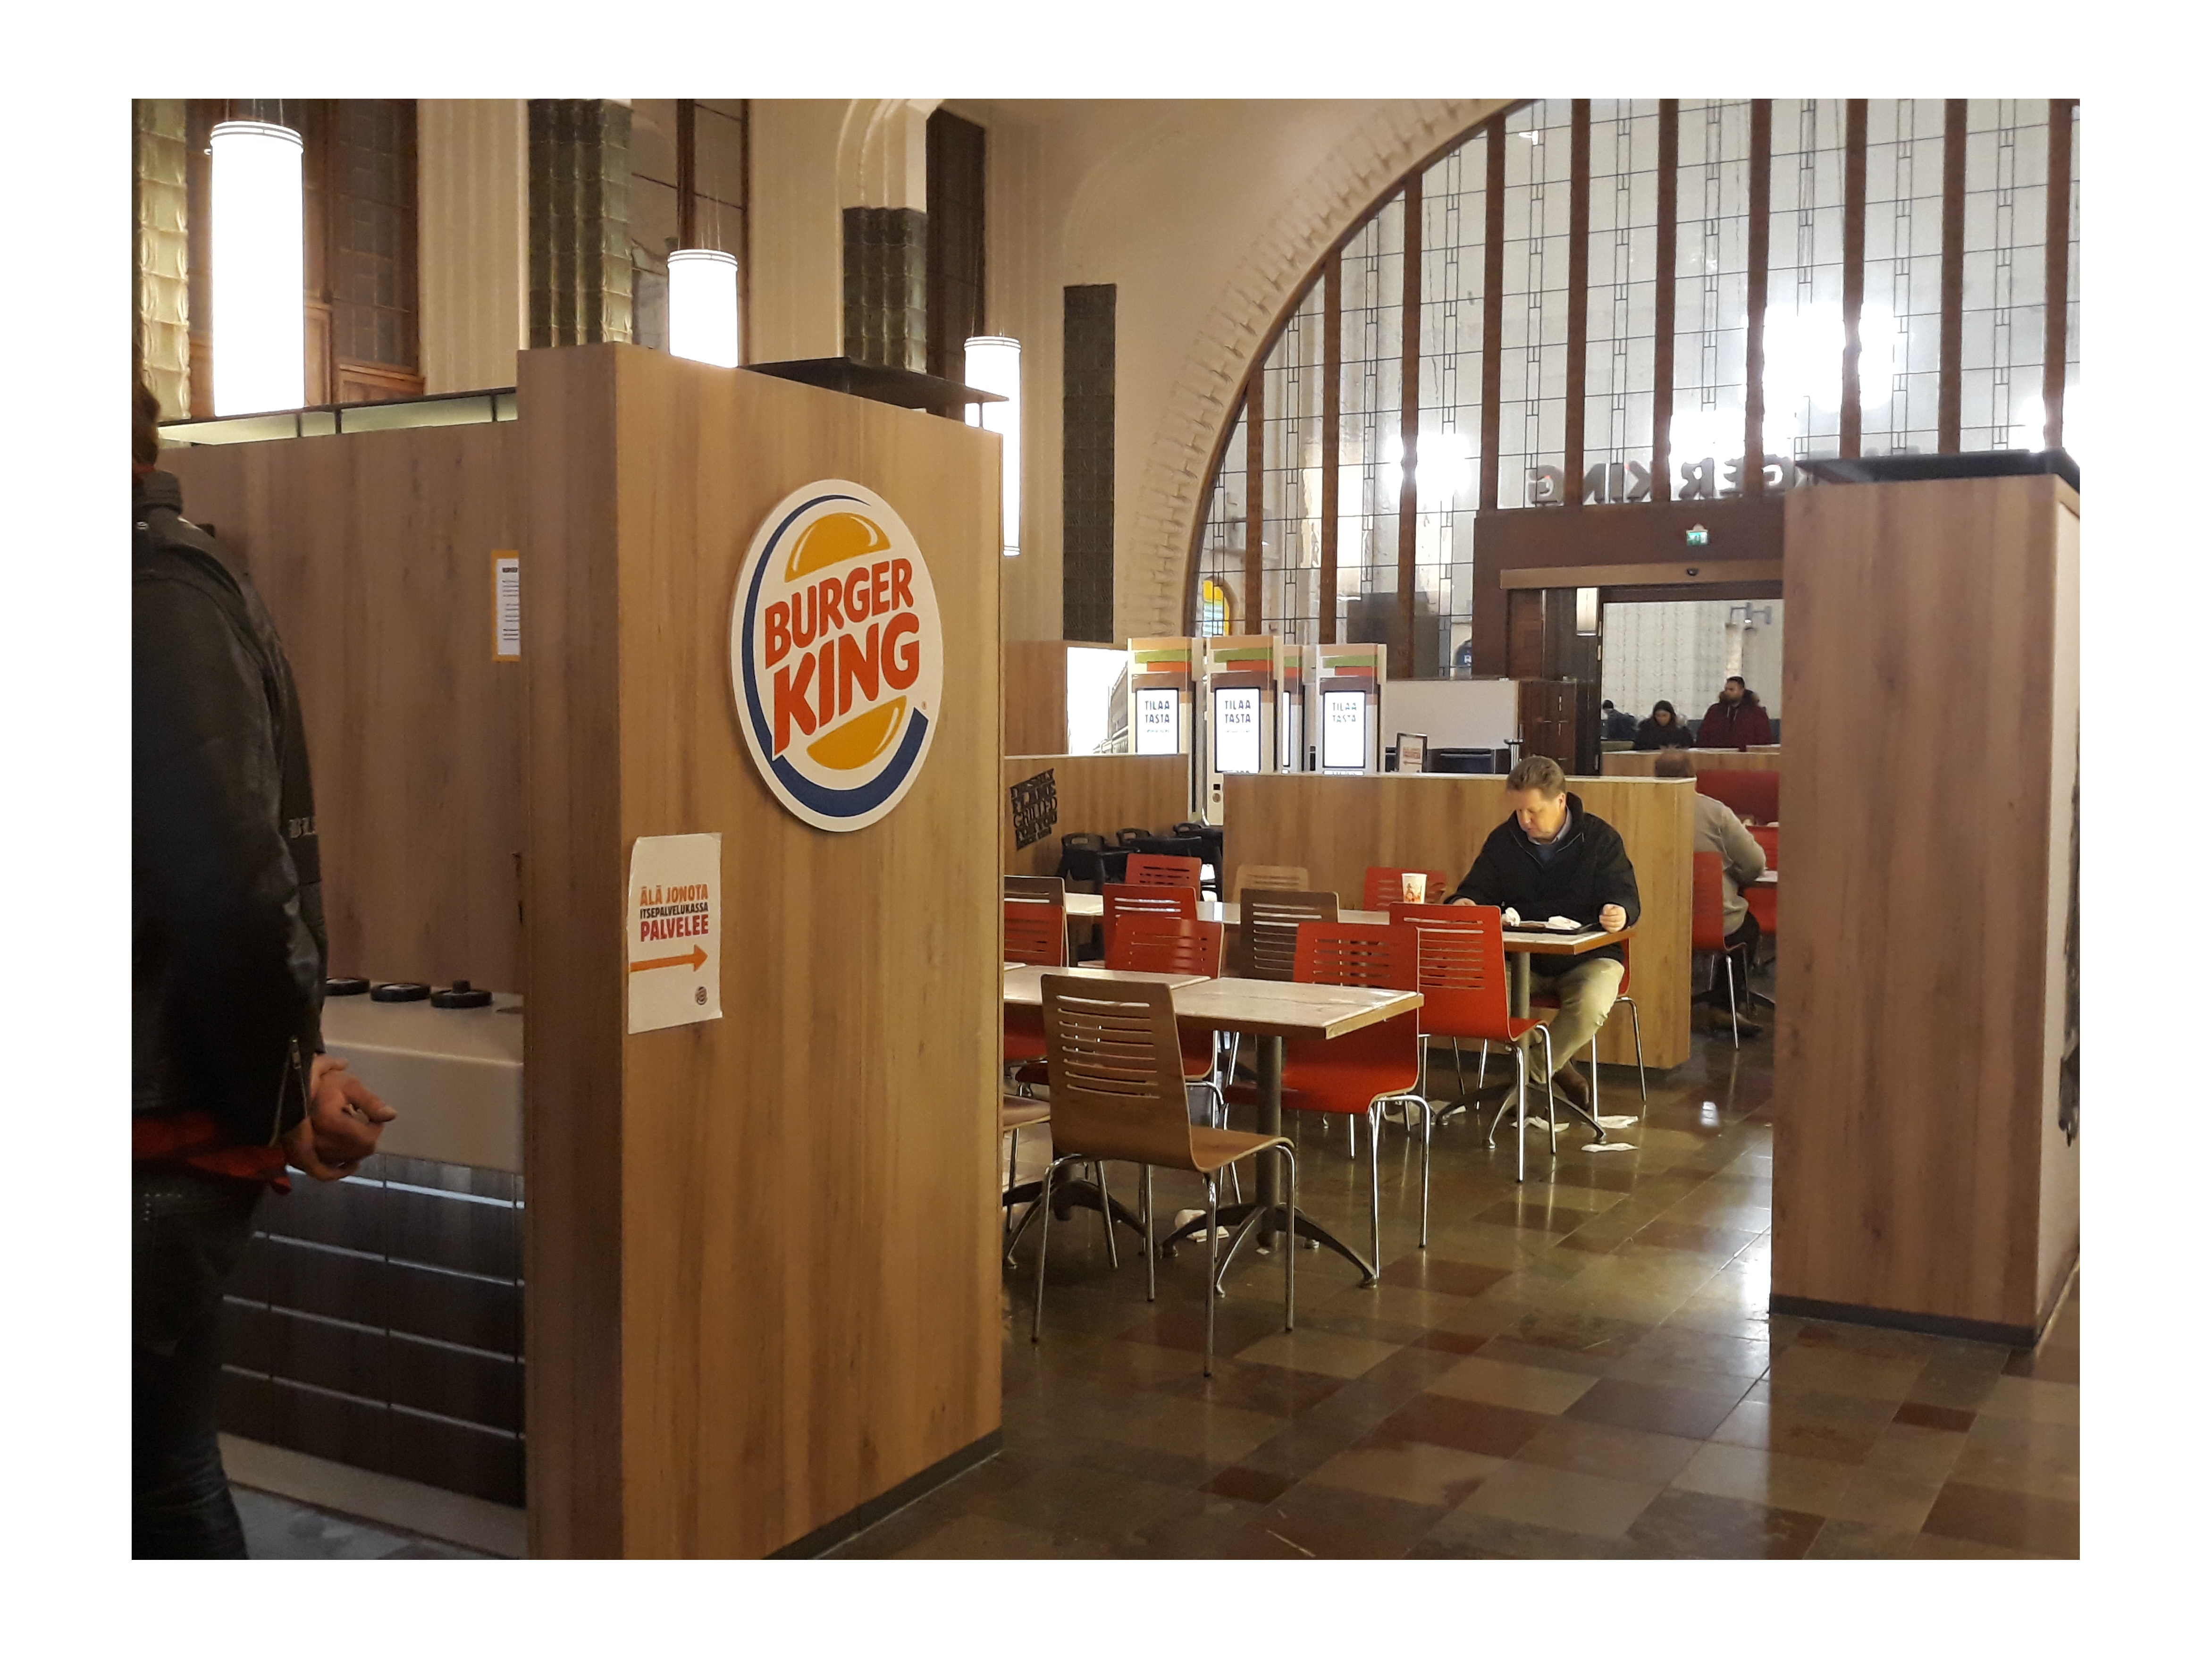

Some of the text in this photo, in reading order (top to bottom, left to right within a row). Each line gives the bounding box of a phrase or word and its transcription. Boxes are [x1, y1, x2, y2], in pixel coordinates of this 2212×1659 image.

[765, 558, 914, 670] BURGER
[774, 612, 919, 756] KING
[1145, 700, 1170, 710] TILAA
[1225, 700, 1251, 710] TILAA
[1145, 714, 1170, 724] TASTA
[1225, 714, 1251, 724] TASTA
[640, 884, 709, 906] ÄLÄ JONOTA
[640, 901, 709, 919] ITSEPALVELUKASSA
[641, 913, 709, 942] PALVELEE
